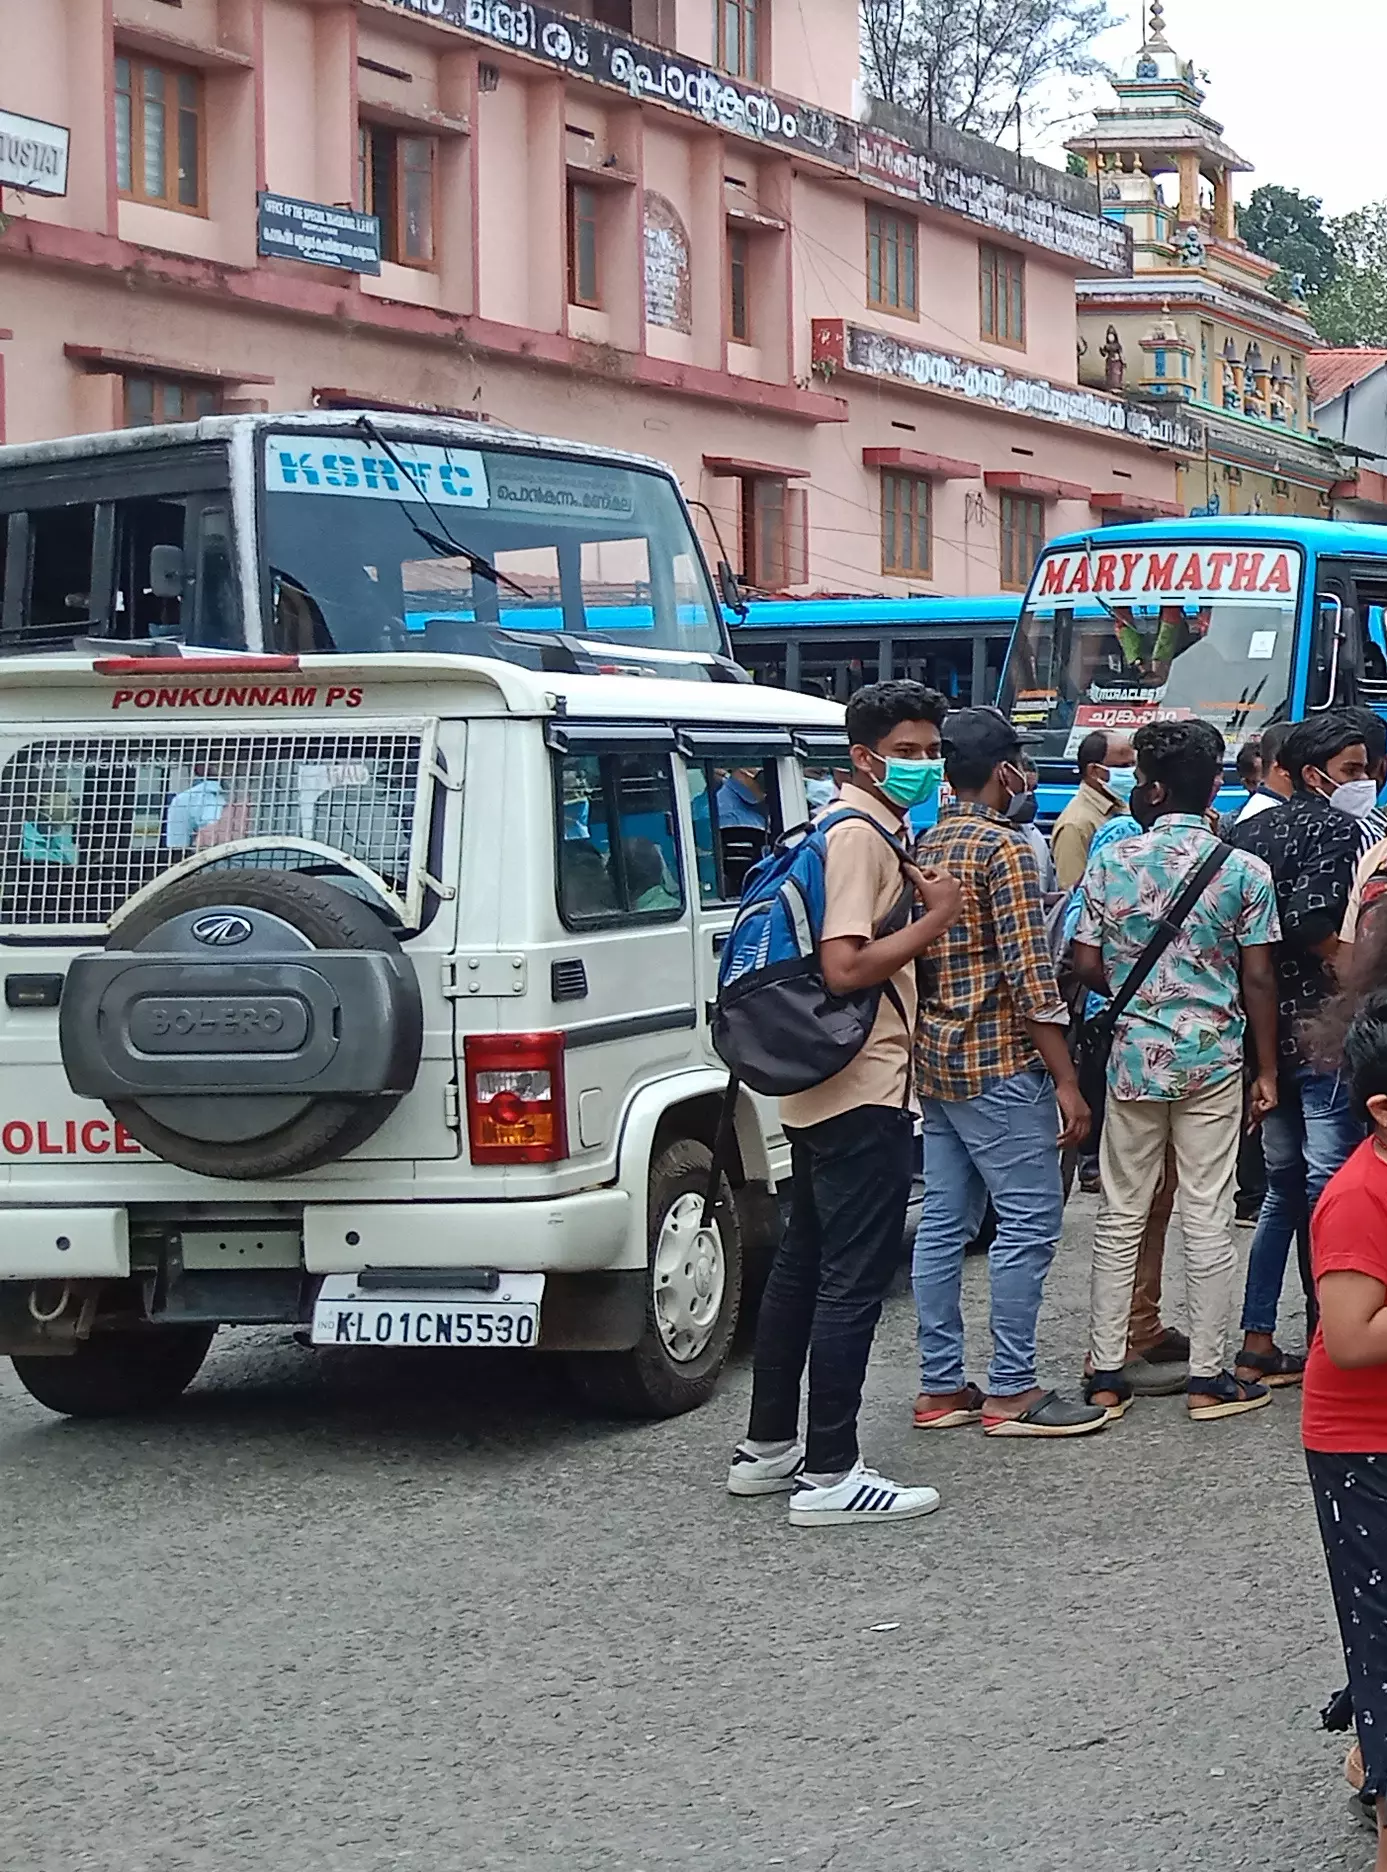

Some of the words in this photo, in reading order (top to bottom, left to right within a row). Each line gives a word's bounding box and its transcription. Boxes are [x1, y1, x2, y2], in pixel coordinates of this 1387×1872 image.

[279, 451, 474, 497] KSRTC
[1039, 553, 1144, 597] MARY
[1142, 553, 1292, 594] MATHA
[112, 687, 316, 710] PONKUNNAM
[325, 687, 364, 708] PS
[152, 1008, 284, 1036] BOLERO
[335, 1311, 533, 1345] KL01CN5530
